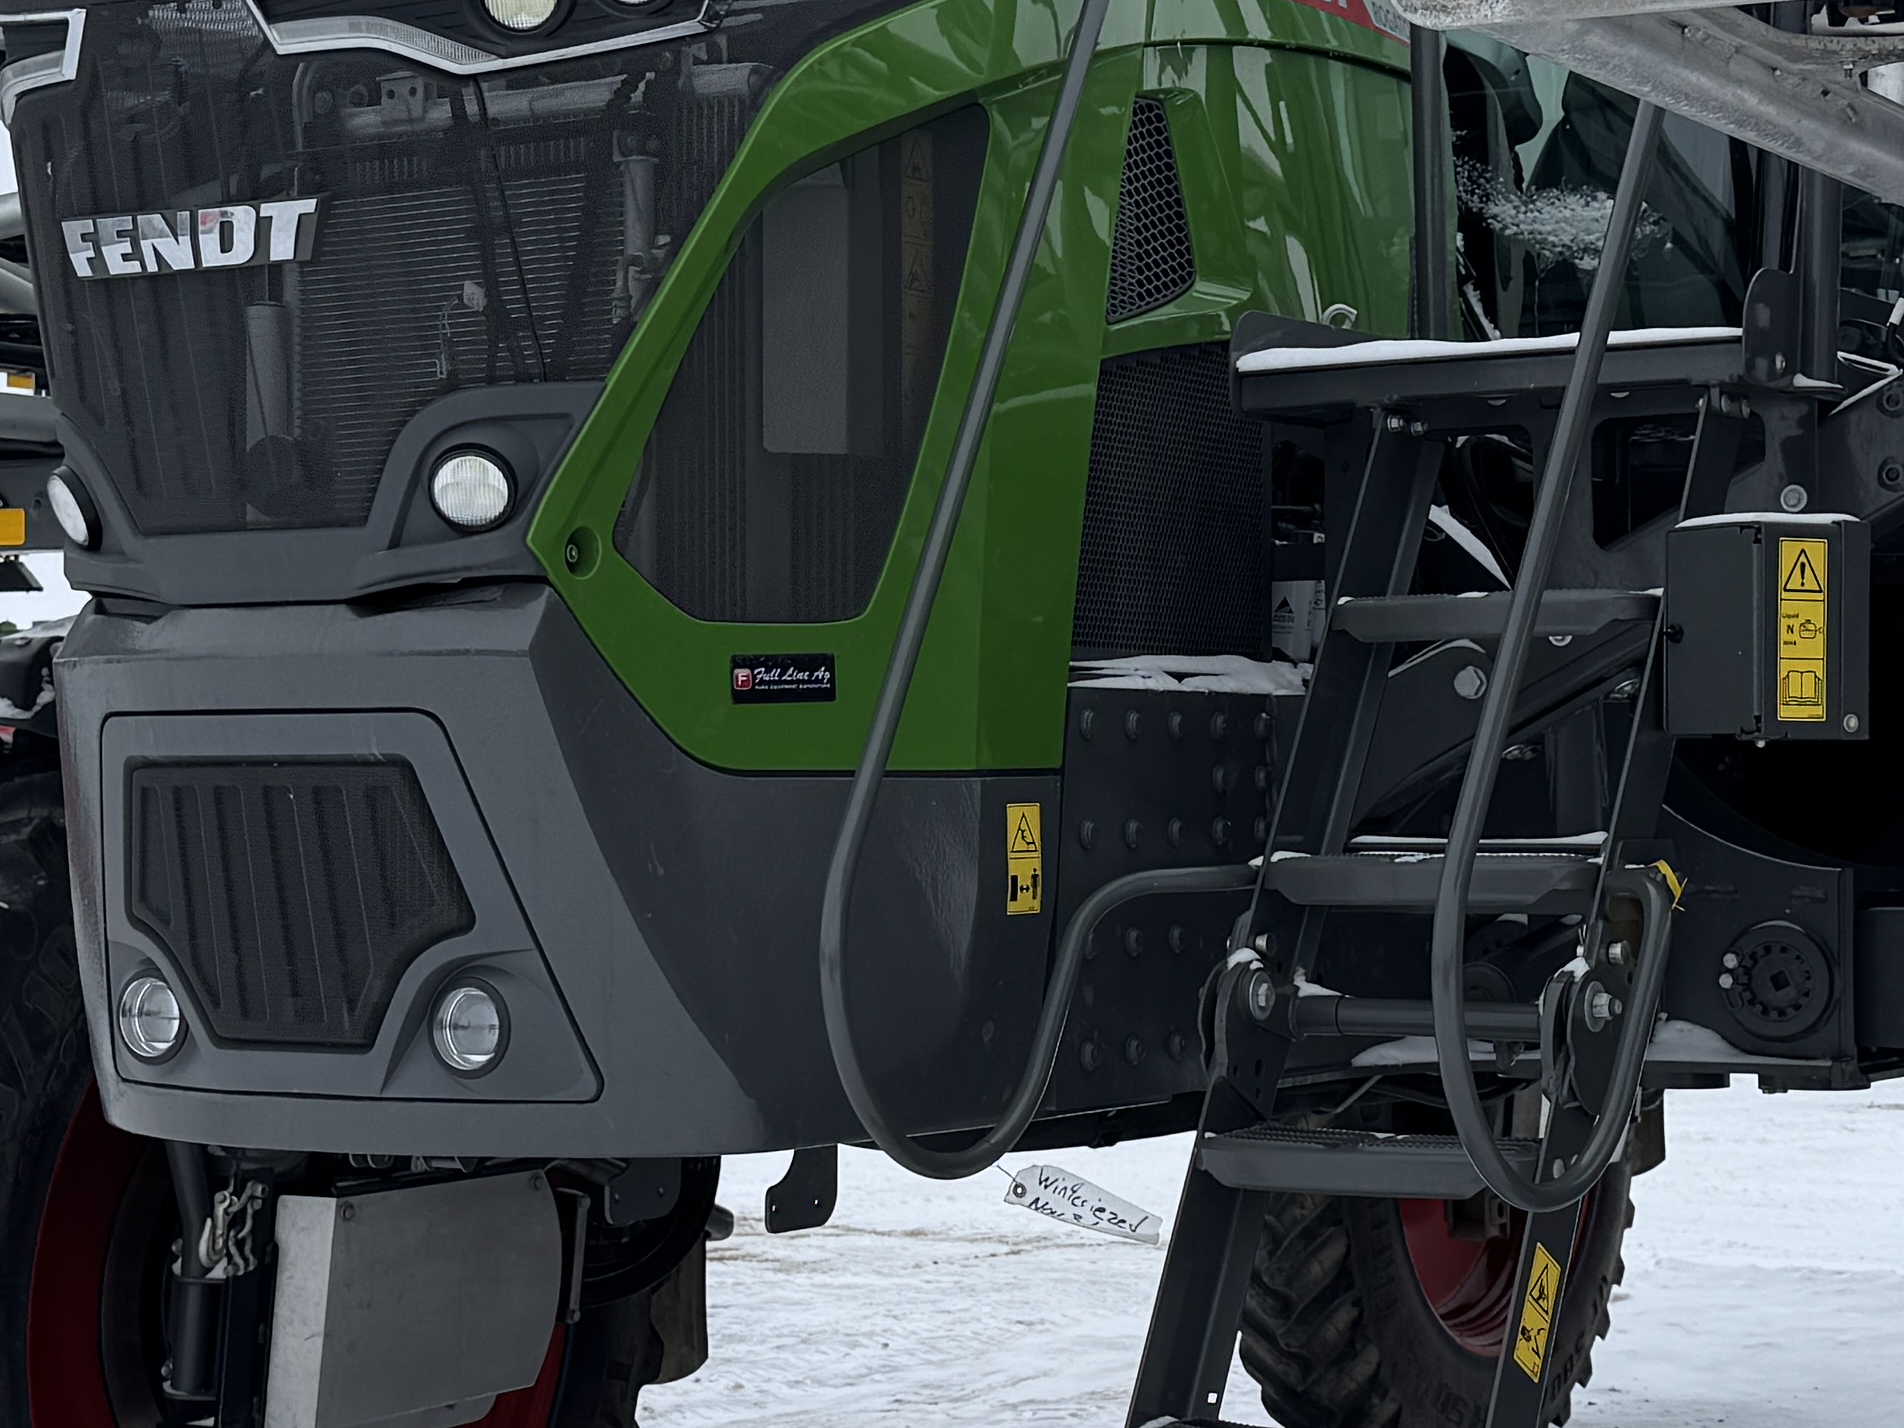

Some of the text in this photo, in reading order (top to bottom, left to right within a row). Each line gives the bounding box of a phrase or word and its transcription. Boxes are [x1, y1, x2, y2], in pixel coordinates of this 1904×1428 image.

[61, 198, 318, 278] FENDT
[753, 667, 781, 684] Full
[781, 666, 810, 680] Line
[811, 666, 831, 683] Ag
